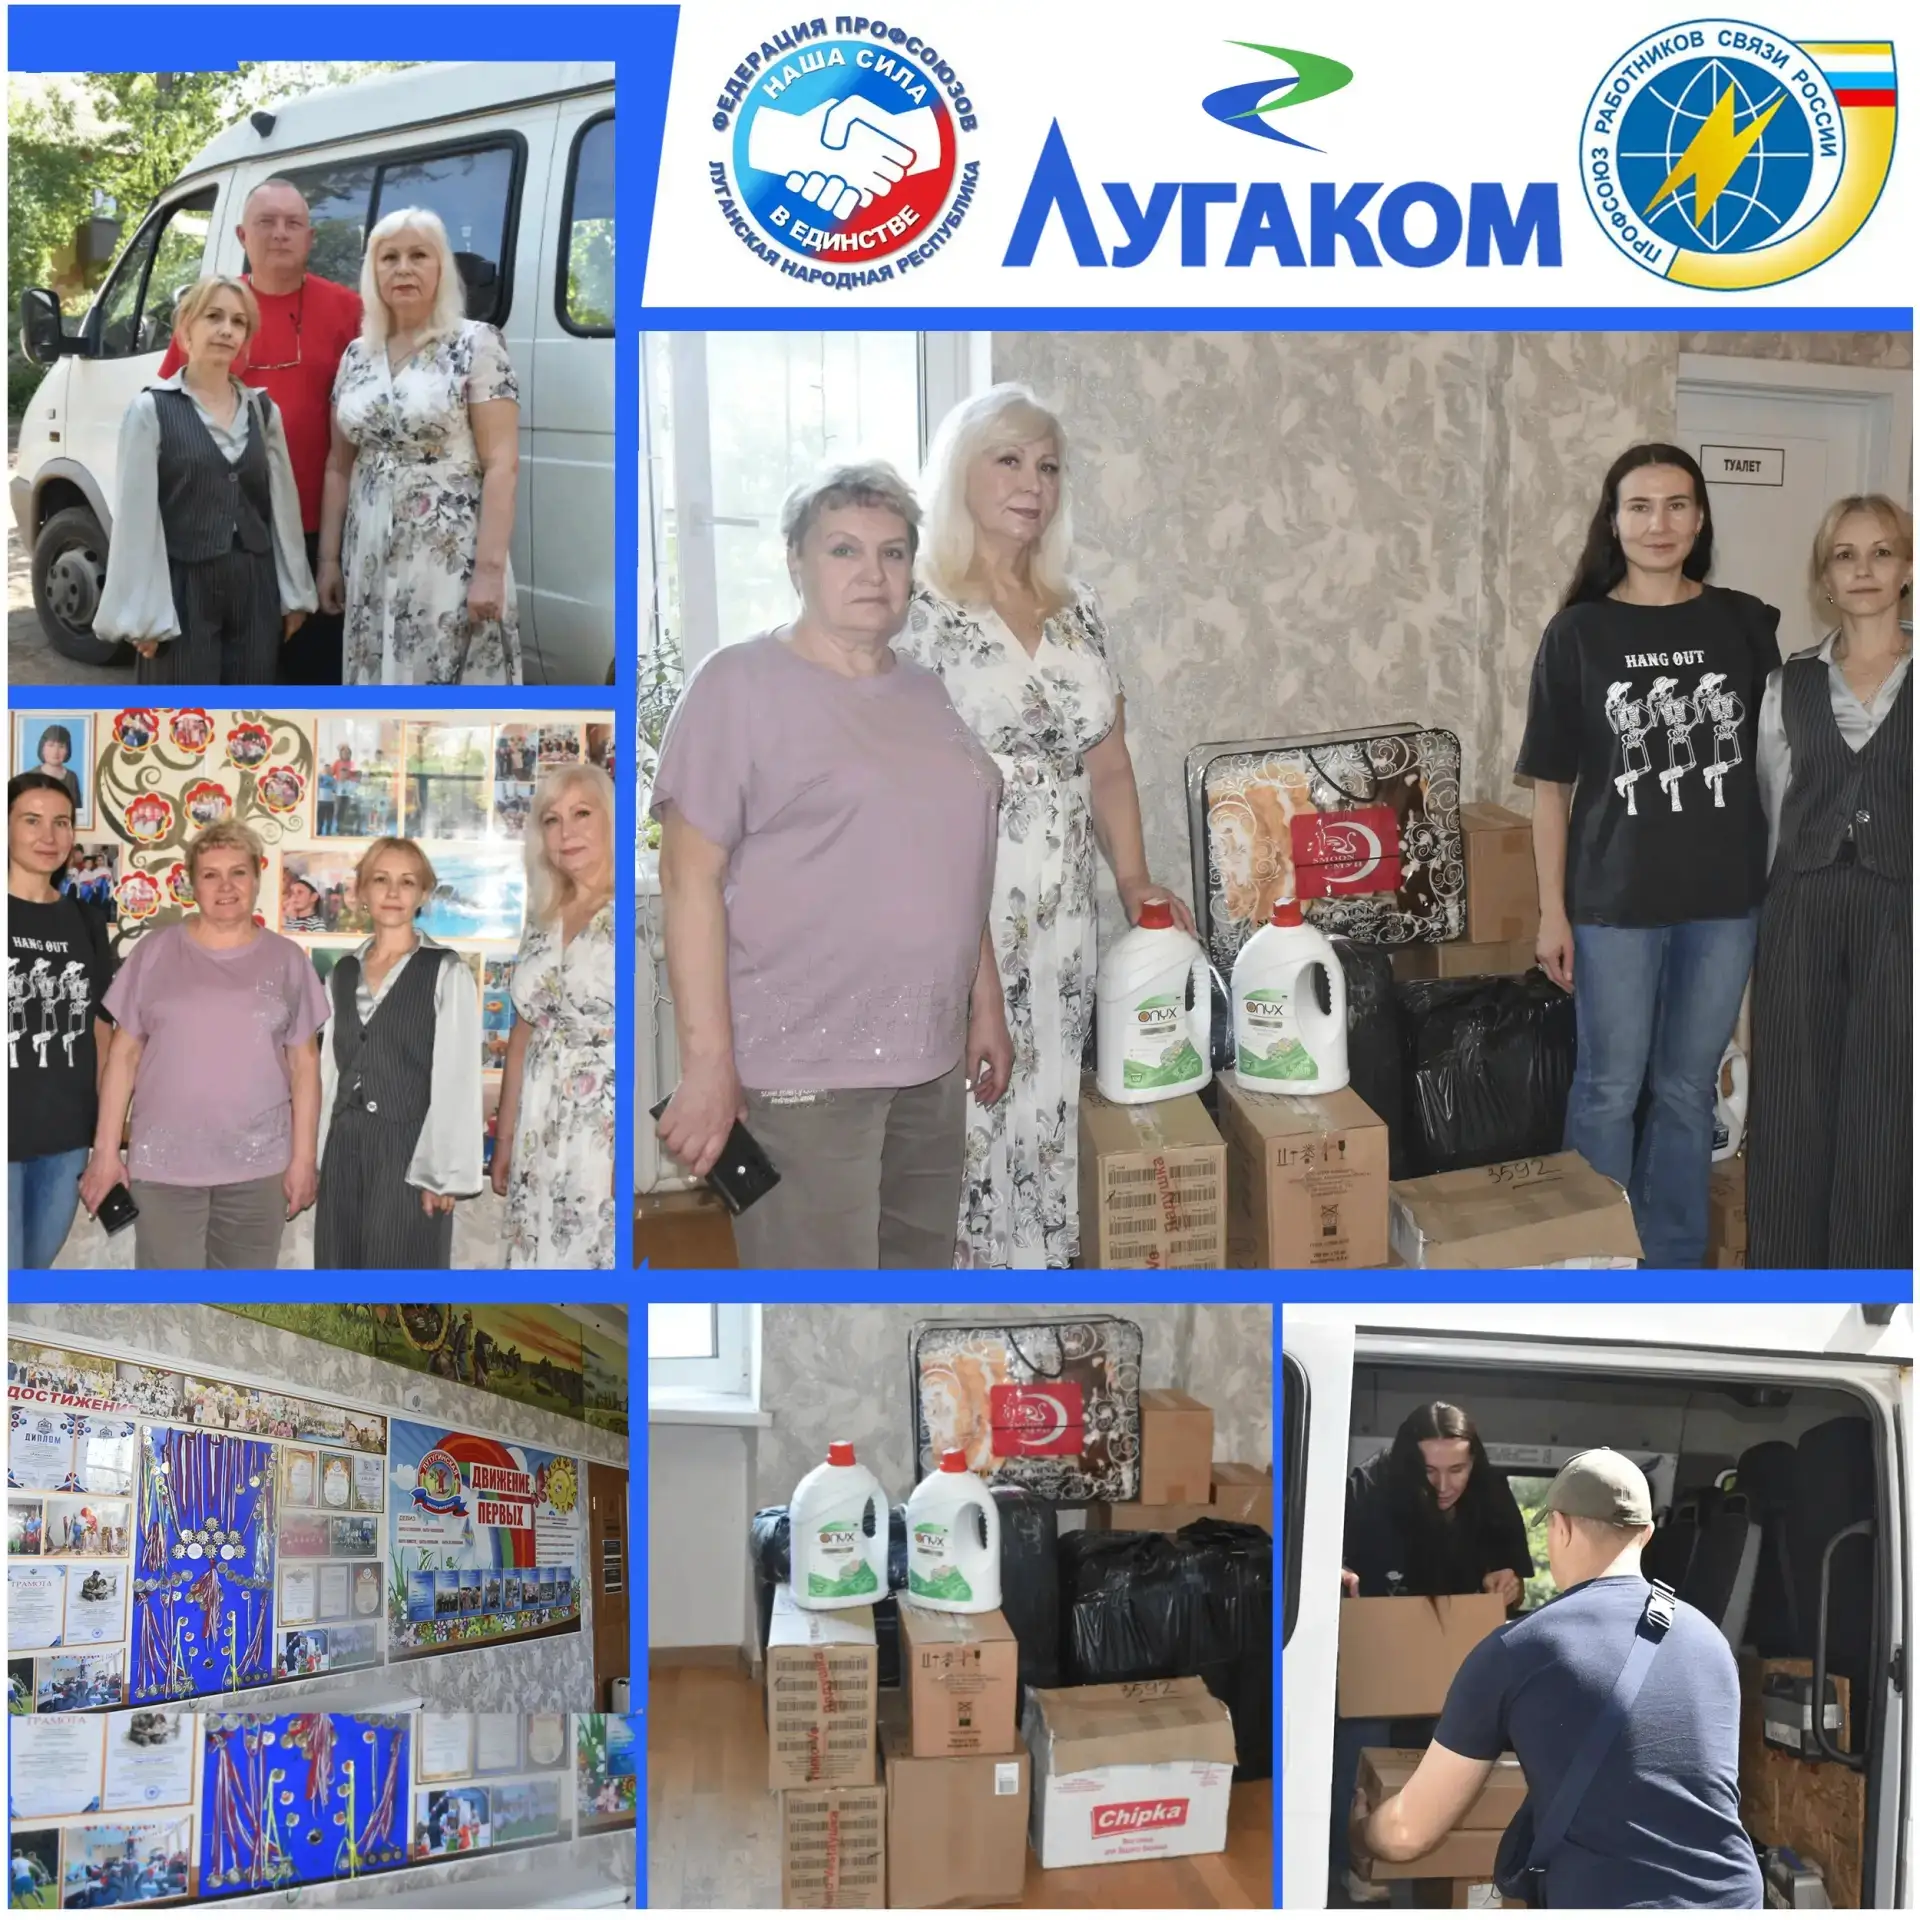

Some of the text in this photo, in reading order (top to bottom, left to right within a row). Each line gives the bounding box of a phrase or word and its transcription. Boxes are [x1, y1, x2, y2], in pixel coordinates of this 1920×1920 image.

[1723, 458, 1762, 473] ТУАЛЕТ
[1624, 652, 1669, 668] HANG
[12, 936, 44, 951] HANG
[1487, 1160, 1561, 1184] 3592
[25, 1433, 61, 1444] ДИПЛОМ
[472, 1465, 531, 1494] ДВИЖЕНИЕ
[477, 1501, 524, 1526] ПЕРВЫХ
[26, 1715, 87, 1727] ГРАМОТА
[1098, 1803, 1182, 1828] Chipka
